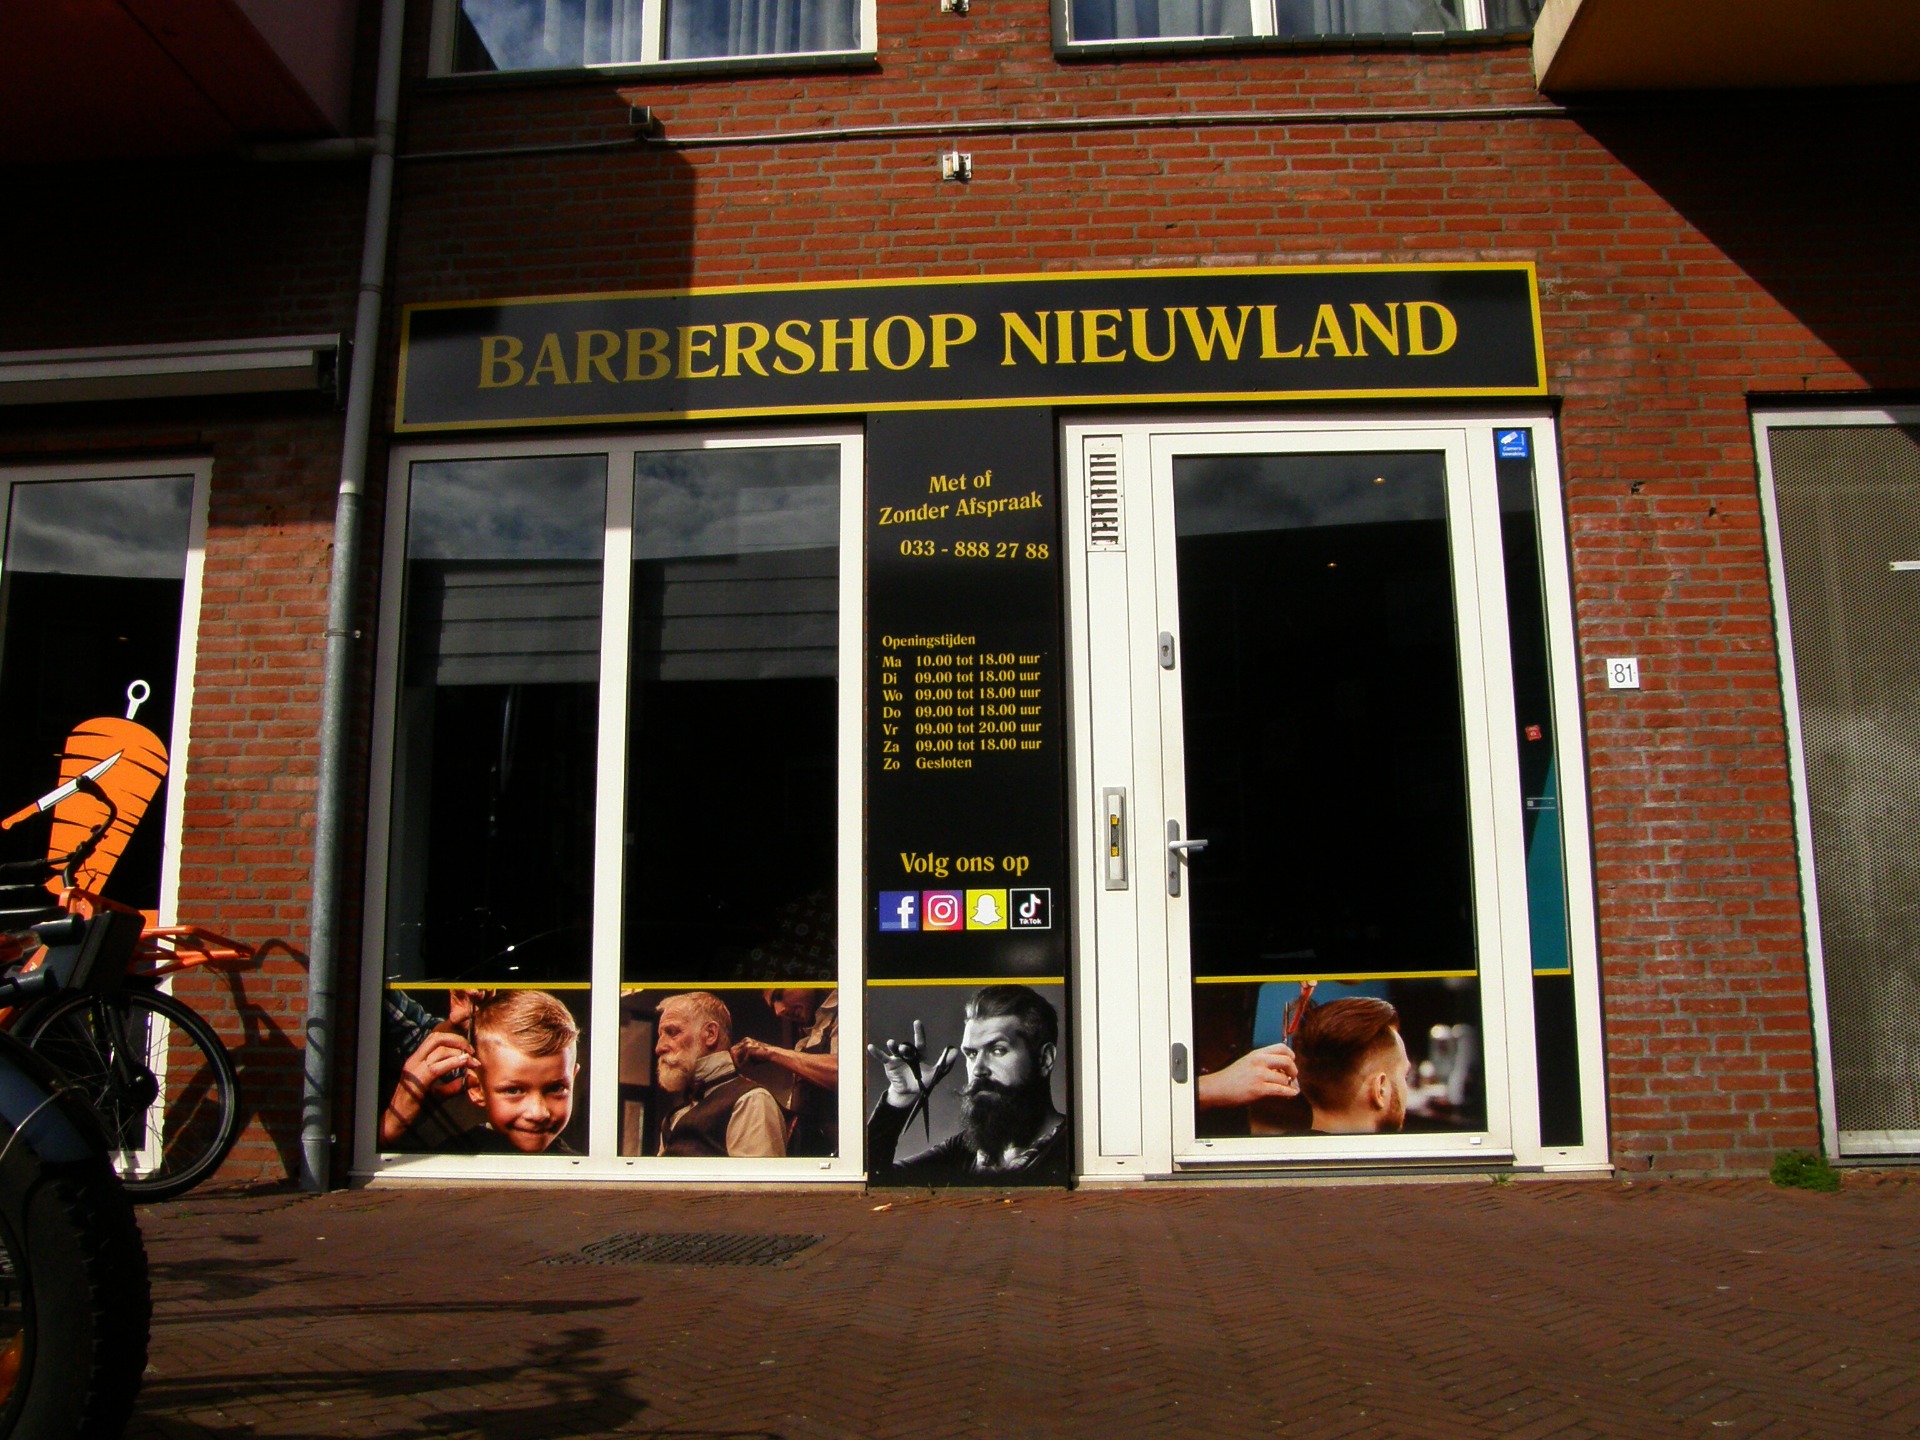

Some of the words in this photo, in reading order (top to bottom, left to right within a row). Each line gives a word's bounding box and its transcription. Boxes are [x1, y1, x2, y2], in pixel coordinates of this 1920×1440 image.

[477, 312, 978, 389] BARBERSHOP
[1000, 301, 1458, 366] NIEUWLAND
[929, 473, 967, 493] Met
[973, 470, 992, 488] of
[879, 503, 949, 525] Zonder
[955, 490, 1043, 517] Afspraak
[900, 540, 935, 556] 033
[954, 541, 989, 557] 888
[996, 542, 1019, 558] 27
[1026, 544, 1049, 559] 88
[882, 634, 975, 649] Openingstijden
[883, 656, 901, 667] Ma
[917, 655, 952, 666] 10.00
[956, 655, 973, 666] tot
[980, 653, 1015, 665] 18.00
[1019, 655, 1041, 664] uur
[883, 673, 896, 684] Di
[915, 672, 952, 683] 09.00
[957, 672, 973, 682] tot
[980, 670, 1015, 682] 18.00
[1020, 671, 1041, 681] uur
[1614, 663, 1633, 683] 81
[883, 690, 902, 701] Wo
[915, 689, 952, 700] 09.00
[957, 689, 973, 699] tot
[981, 687, 1015, 699] 18.00
[1020, 688, 1041, 698] uur
[884, 707, 901, 718] Do
[916, 706, 953, 717] 09.00
[957, 706, 974, 716] tot
[981, 704, 1016, 716] 18.00
[1020, 705, 1041, 715] uur
[883, 724, 897, 735] Vr
[916, 723, 953, 734] 09.00
[957, 723, 974, 733] tot
[979, 721, 1016, 733] 20.00
[1021, 722, 1042, 732] uur
[883, 741, 899, 752] Za
[916, 740, 953, 751] 09.00
[958, 740, 974, 751] tot
[981, 738, 1016, 750] 18.00
[1021, 740, 1042, 749] uur
[884, 758, 900, 769] Zo
[916, 757, 971, 769] Gesloten
[900, 852, 949, 877] Volg
[956, 857, 994, 872] ons
[1003, 856, 1029, 876] op
